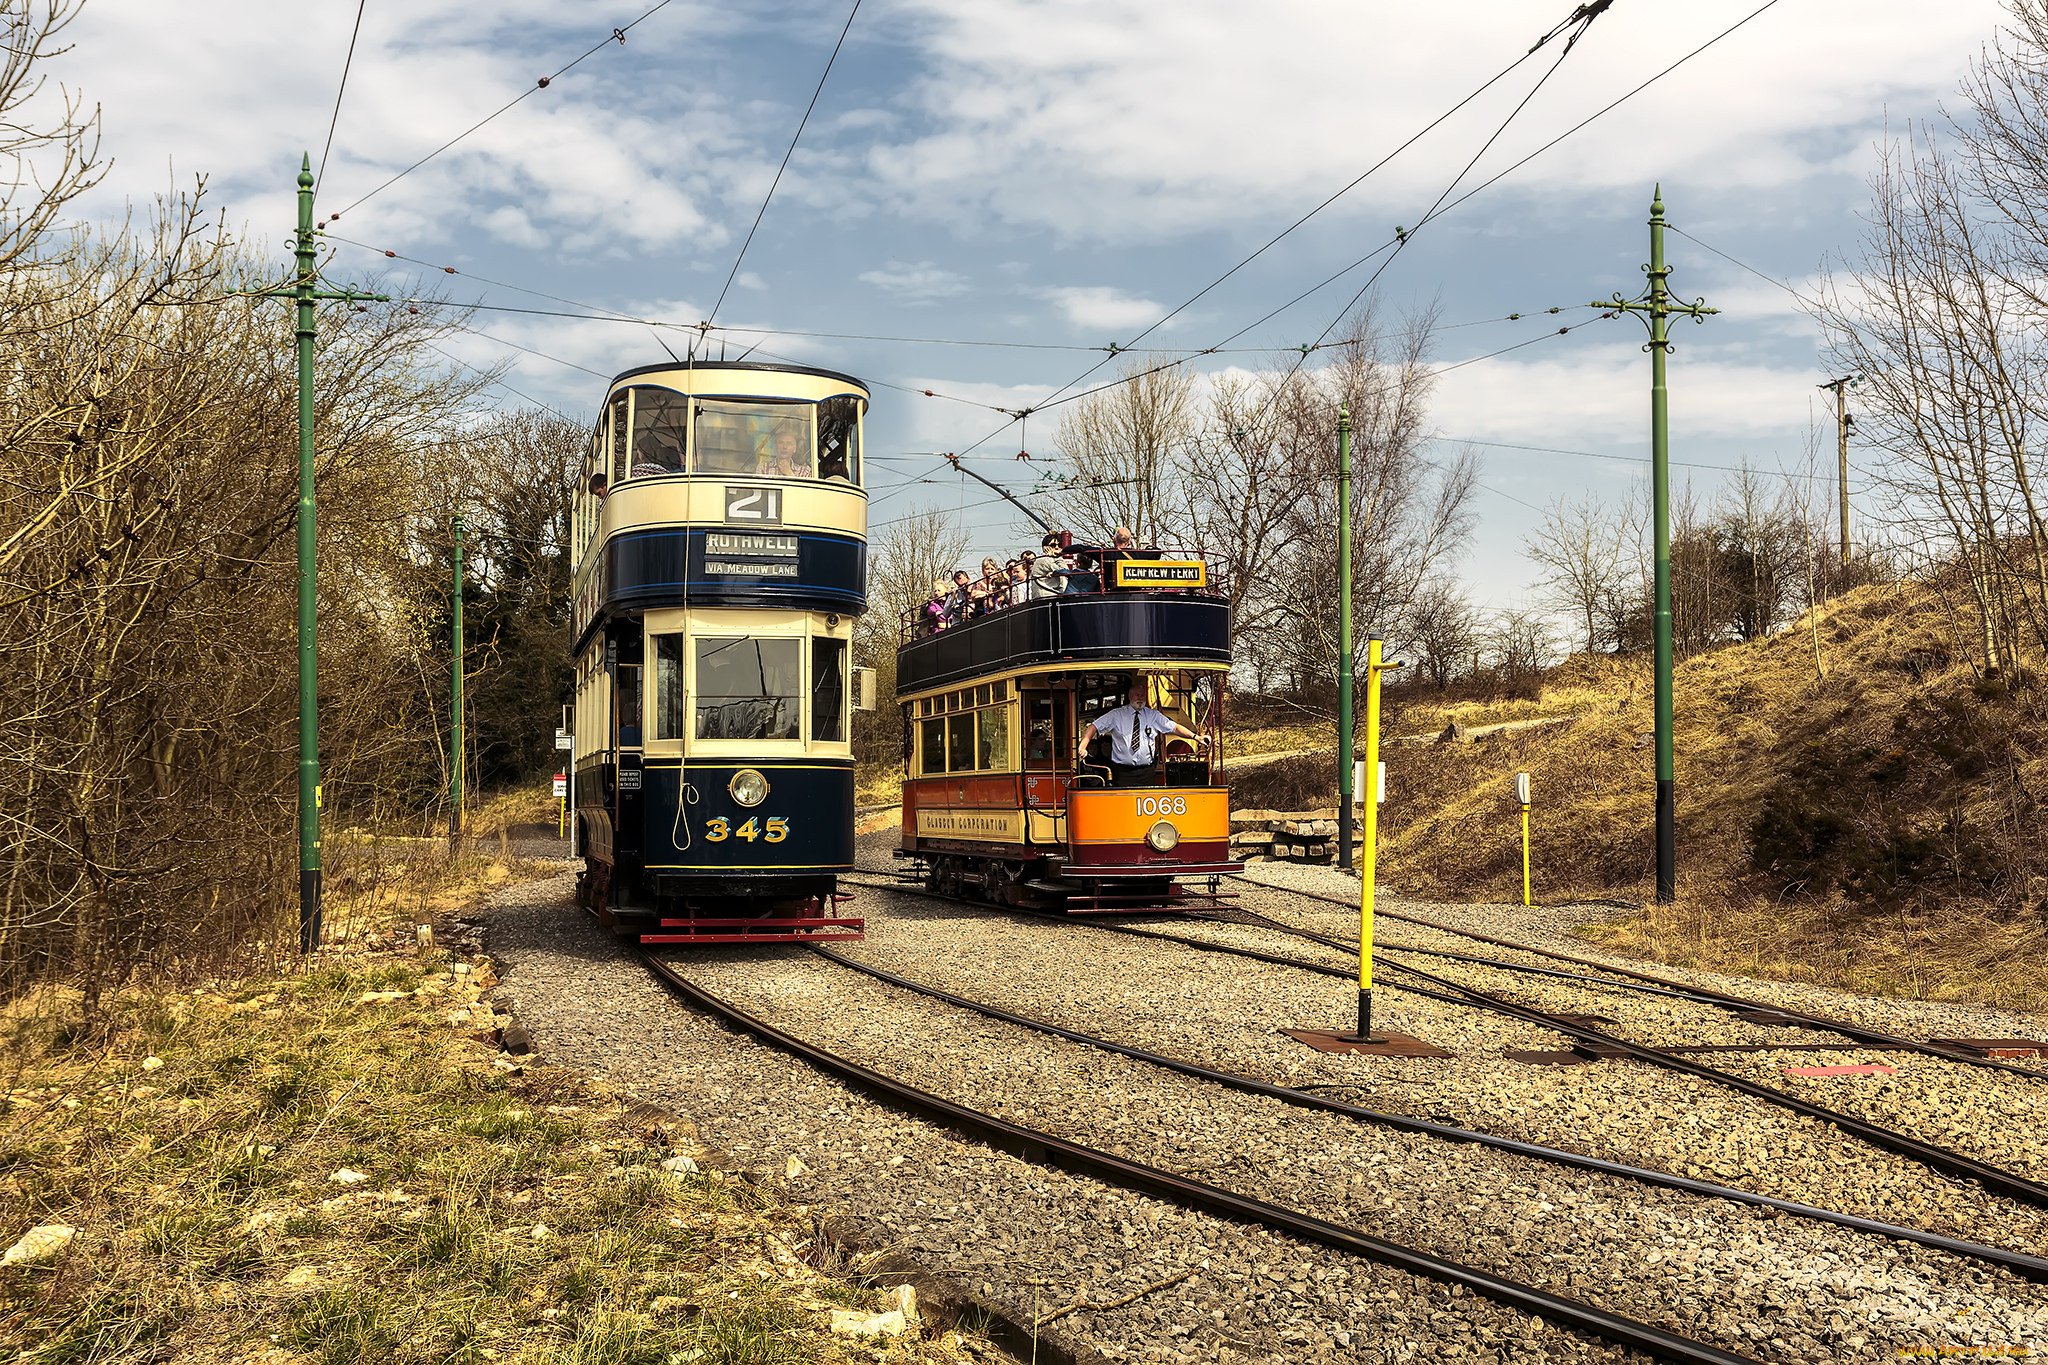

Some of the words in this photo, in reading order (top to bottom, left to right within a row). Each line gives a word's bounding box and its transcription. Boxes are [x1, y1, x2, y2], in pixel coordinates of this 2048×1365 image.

[728, 488, 778, 519] 21
[708, 565, 723, 573] VIA
[727, 564, 769, 575] MEADOW
[772, 566, 796, 575] LANE
[1136, 796, 1187, 816] 1068
[704, 816, 790, 843] 345
[926, 815, 955, 829] GLASGOW
[958, 816, 1008, 831] CORPORATION
